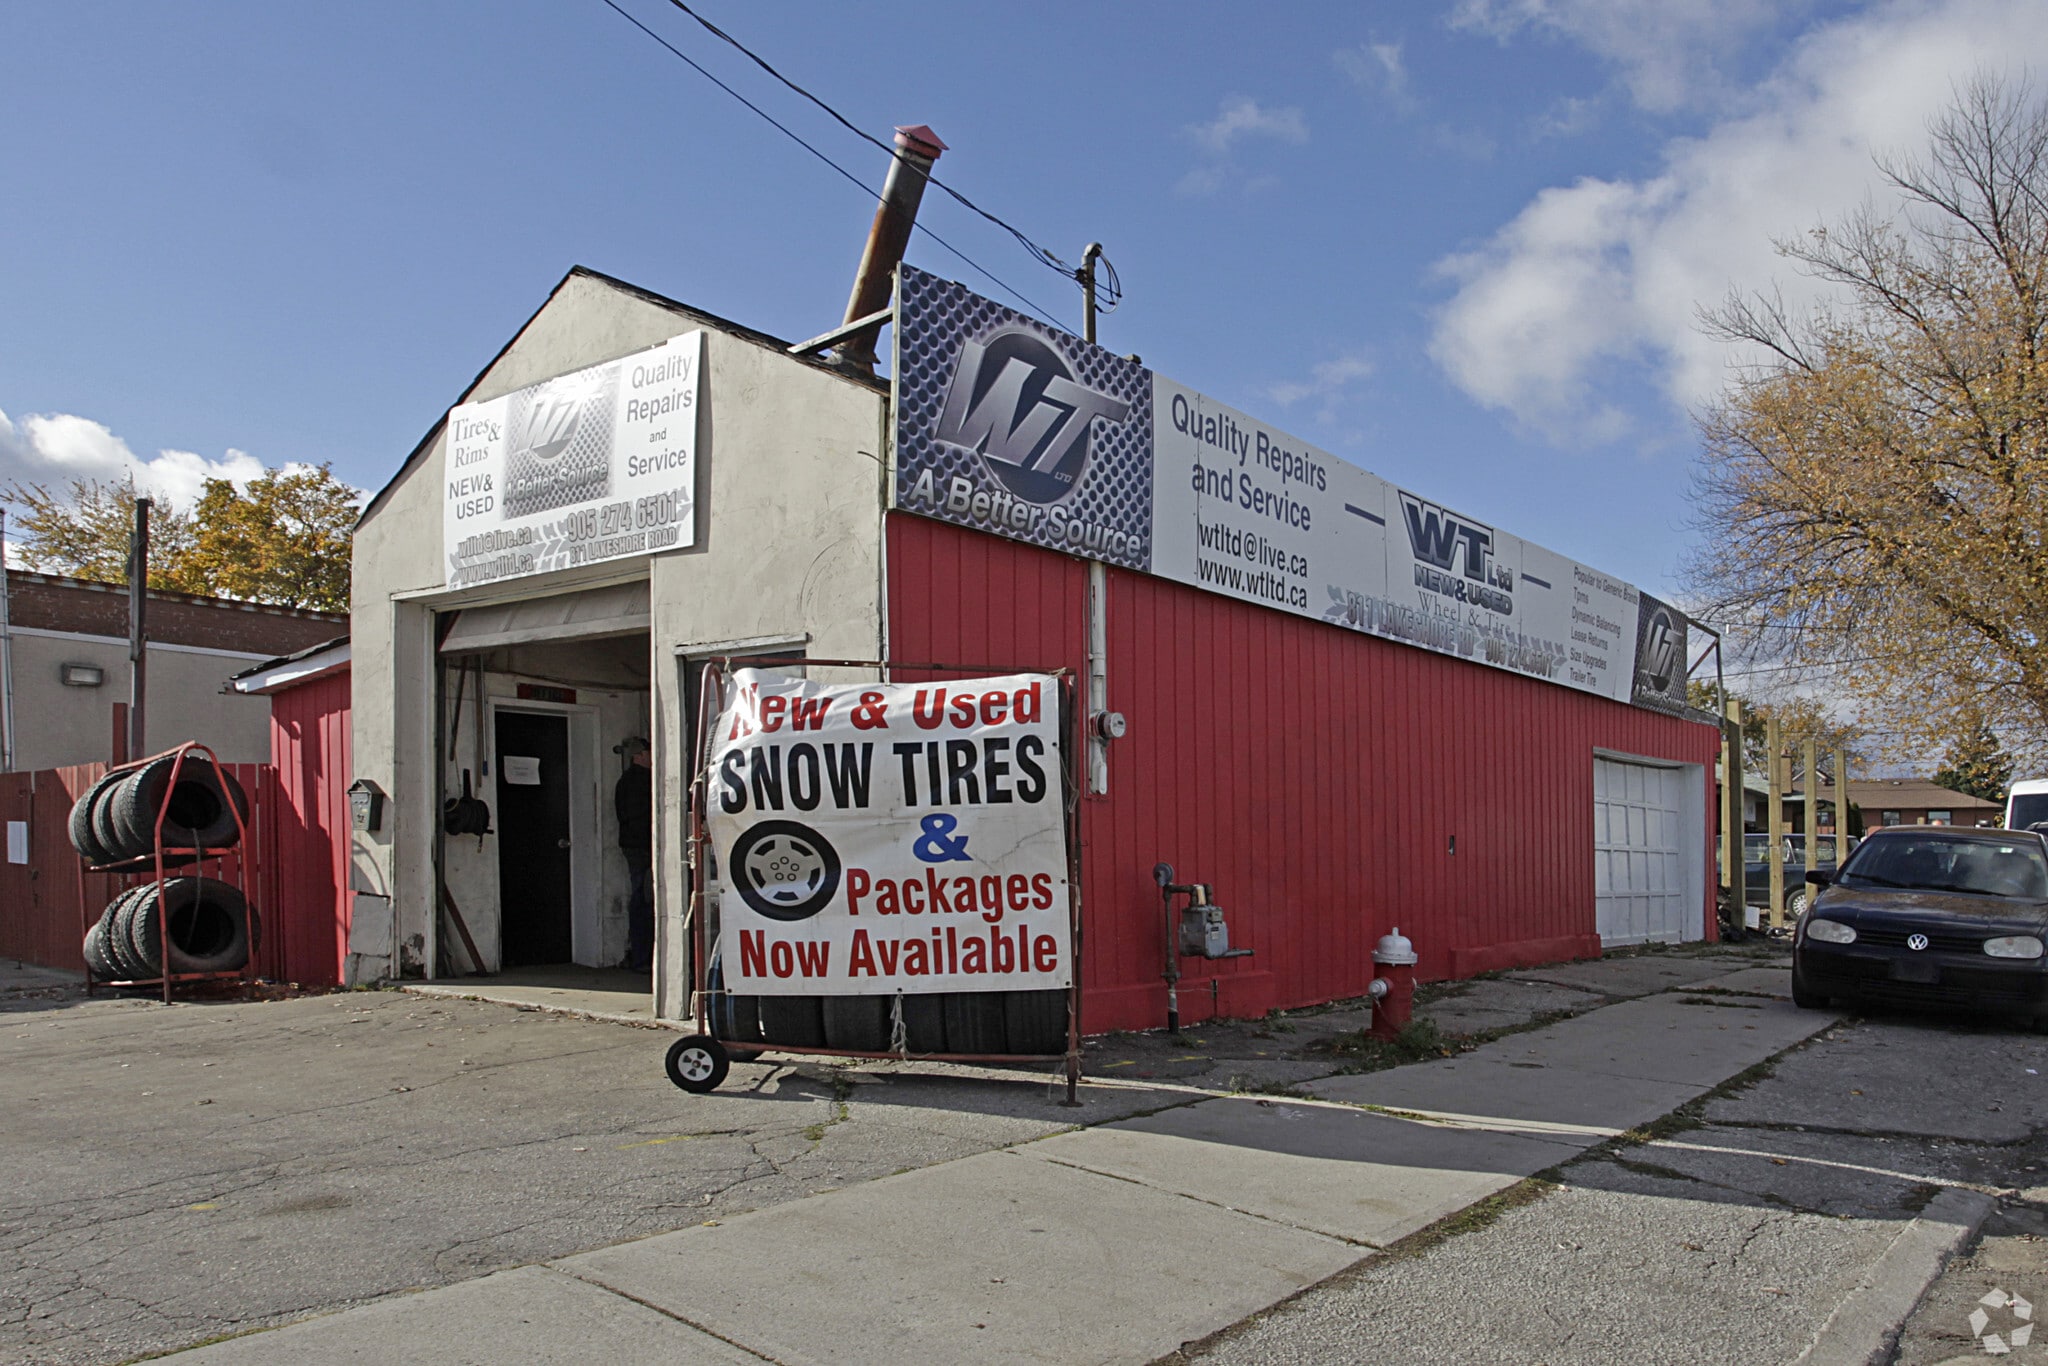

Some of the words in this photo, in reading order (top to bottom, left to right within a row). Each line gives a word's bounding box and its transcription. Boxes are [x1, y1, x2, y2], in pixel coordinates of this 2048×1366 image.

[631, 354, 692, 390] Quality
[627, 388, 692, 423] Repairs
[934, 340, 1130, 474] WT
[454, 444, 489, 469] Rims
[649, 428, 667, 443] and
[1171, 393, 1249, 466] Quality
[1256, 430, 1326, 492] Repairs
[504, 481, 514, 503] A
[515, 474, 555, 500] Better
[558, 461, 609, 491] Source
[627, 449, 687, 478] Service
[456, 495, 494, 520] USED
[567, 506, 597, 542] 905
[600, 501, 632, 537] 274
[635, 491, 678, 530] 6501
[908, 468, 936, 505] A
[946, 475, 1043, 532] Better
[1047, 504, 1143, 559] Source
[1192, 463, 1233, 503] and
[1239, 473, 1311, 531] Service
[569, 545, 588, 564] 811
[588, 532, 645, 561] LAKESHORE
[648, 526, 678, 548] ROAD
[1199, 523, 1308, 578] wtltd@live.ca
[1398, 489, 1494, 582] WT
[1486, 559, 1513, 592] Ltd
[1199, 558, 1307, 609] www.wtltd.ca
[1574, 566, 1595, 588] Popular
[1602, 576, 1623, 602] Generic
[1346, 591, 1374, 629] 811
[1378, 600, 1455, 652] LAKESHORE
[1457, 626, 1474, 656] RD
[1485, 636, 1506, 665] 905
[1418, 590, 1461, 622] Wheel
[1468, 608, 1481, 628] &
[1485, 611, 1511, 637] Tire
[1571, 606, 1595, 627] Dynamic
[1596, 615, 1621, 639] Balancing
[1570, 626, 1587, 643] Lease
[1588, 632, 1608, 650] Returns
[1570, 647, 1581, 664] Size
[1582, 651, 1607, 670] Upgrades
[1569, 667, 1587, 684] Trailer
[1586, 672, 1597, 686] Tire
[728, 682, 834, 741] New
[850, 691, 889, 731] &
[912, 682, 1041, 730] Used
[720, 742, 874, 814] SNOW
[893, 735, 1047, 807] TIRES
[912, 813, 974, 863] &
[846, 867, 1053, 923] Packages
[739, 929, 831, 978] Now
[848, 924, 1058, 978] Available
